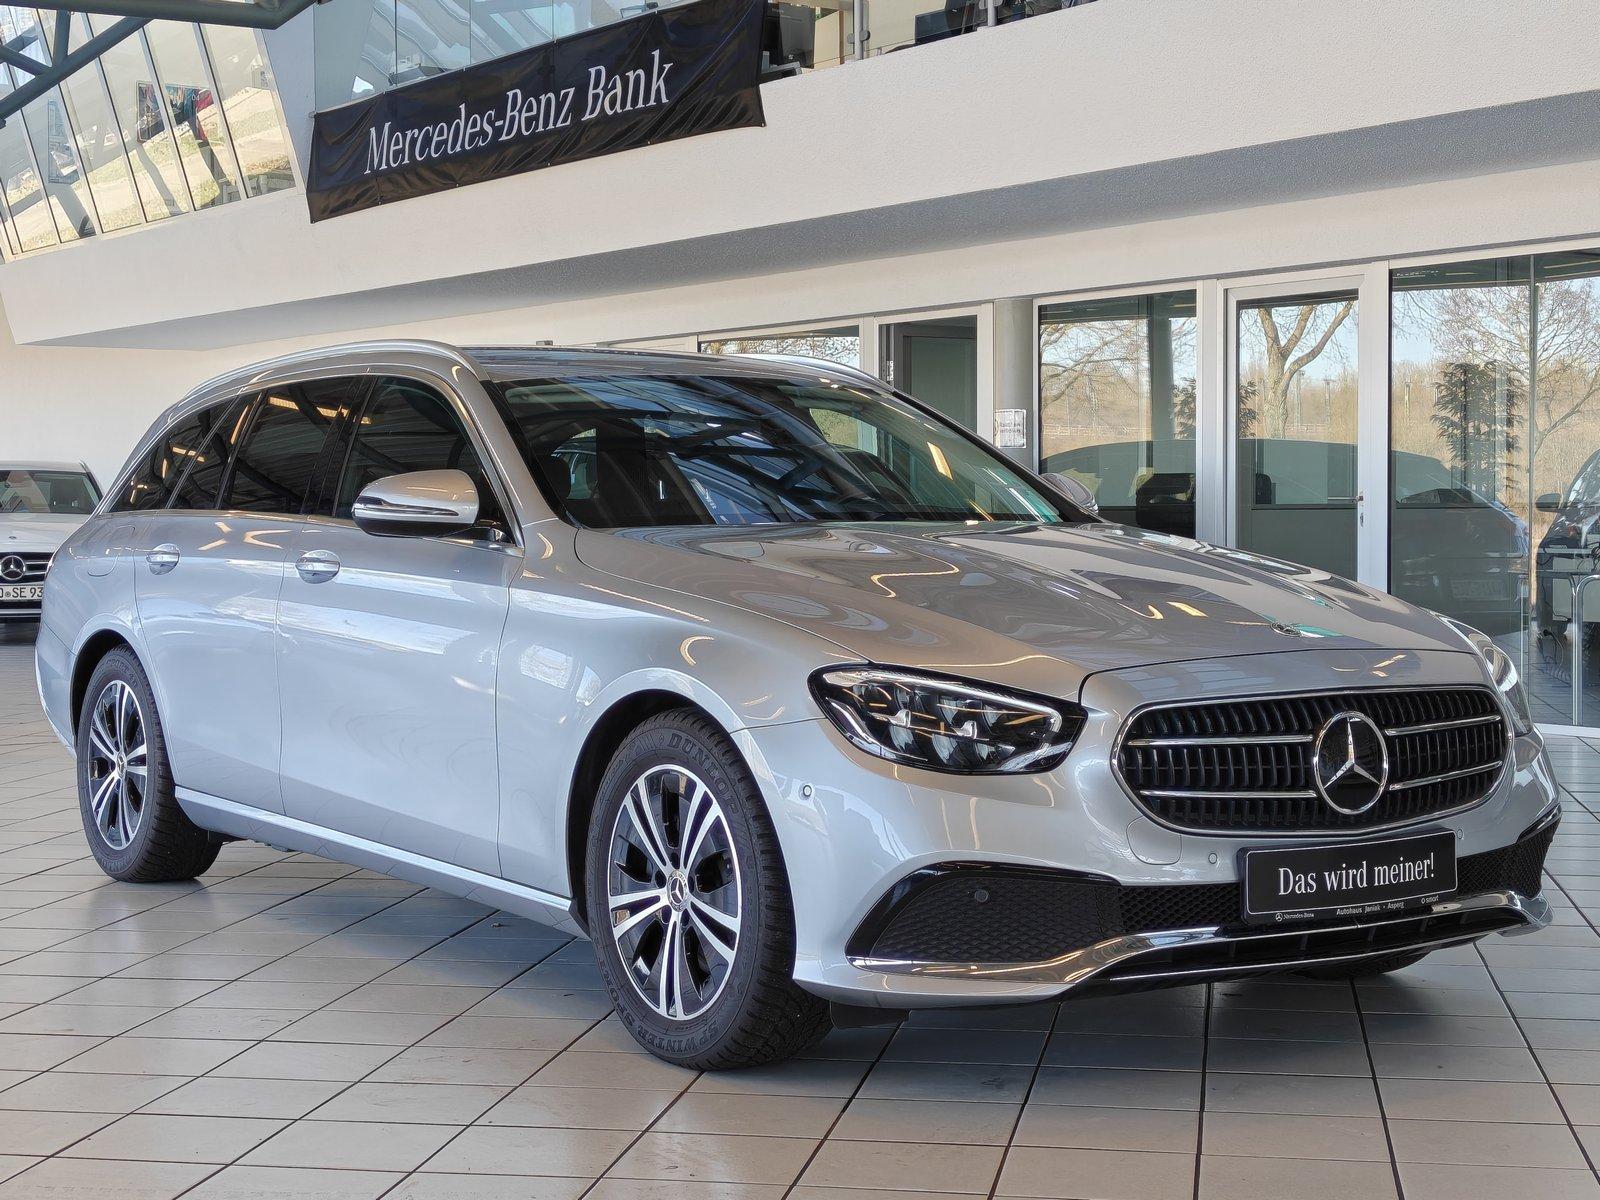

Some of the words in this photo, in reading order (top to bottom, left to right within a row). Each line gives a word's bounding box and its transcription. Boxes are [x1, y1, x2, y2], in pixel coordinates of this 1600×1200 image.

[364, 87, 576, 174] Mercedes-Benz
[581, 48, 674, 122] Bank
[12, 587, 27, 598] SE
[667, 732, 740, 814] DUNLOP
[1278, 867, 1317, 896] Das
[1323, 861, 1368, 892] wird
[1373, 852, 1435, 887] meiner!
[1336, 907, 1363, 915] Autohaus
[637, 1025, 698, 1053] WINTER
